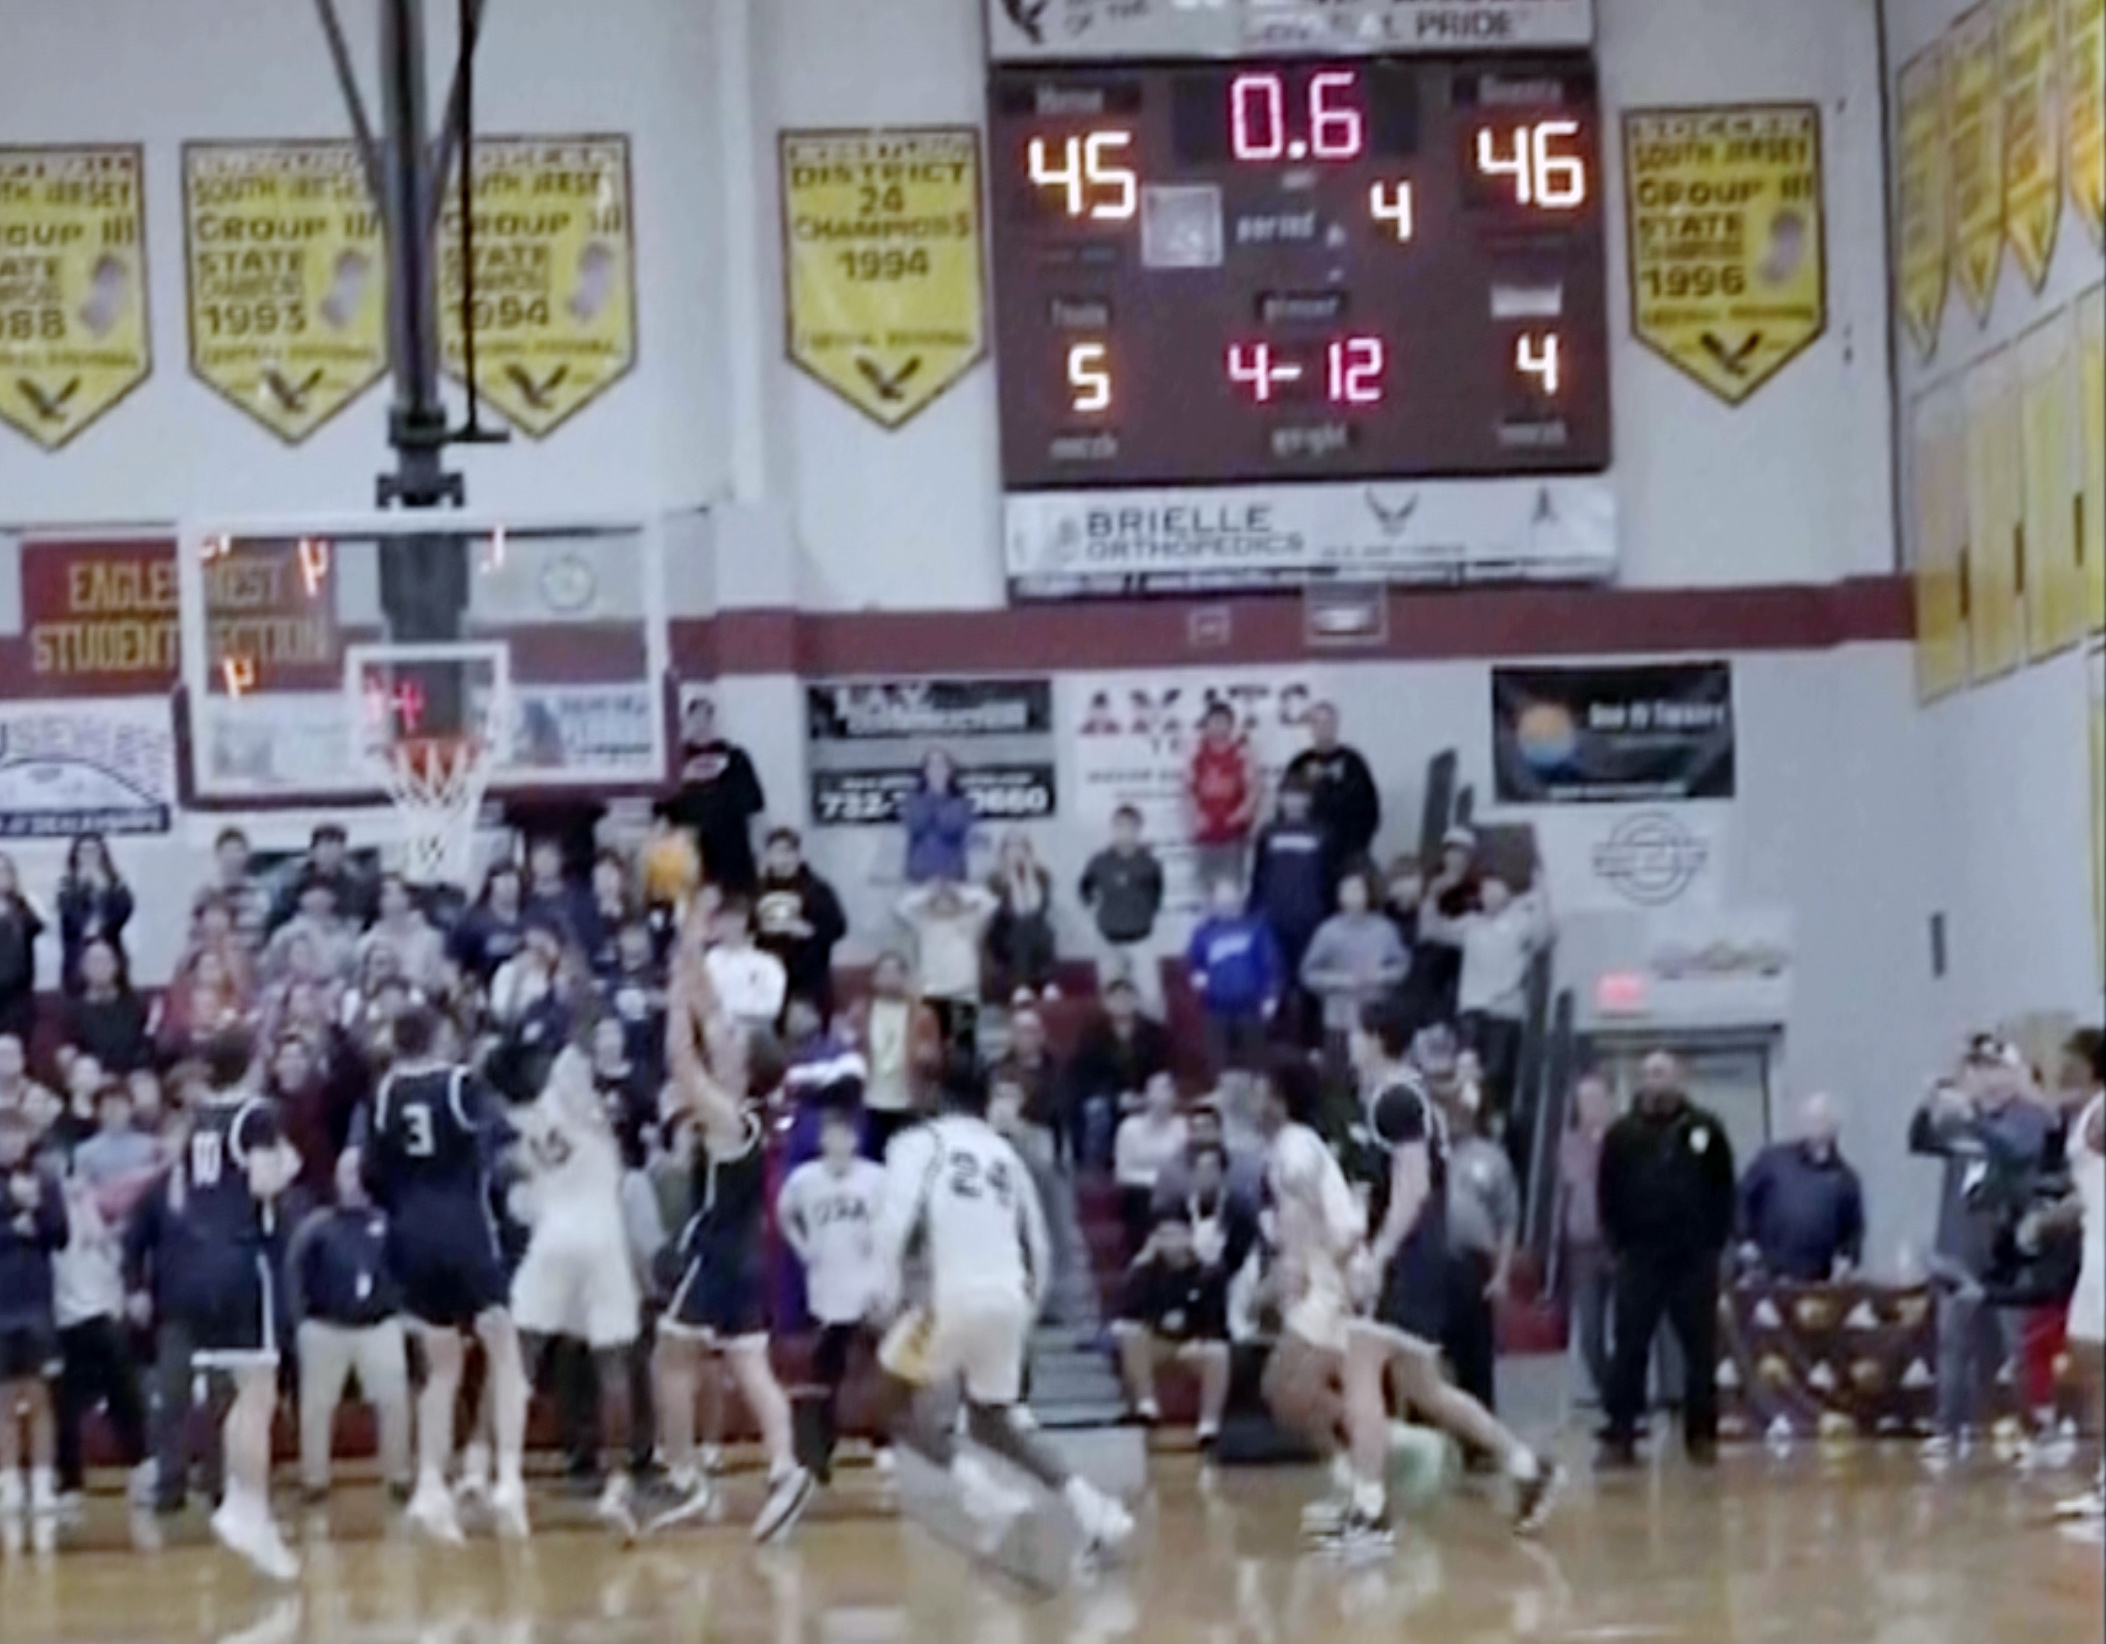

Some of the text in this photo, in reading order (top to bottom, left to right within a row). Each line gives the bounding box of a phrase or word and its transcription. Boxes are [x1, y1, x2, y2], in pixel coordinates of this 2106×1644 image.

[1416, 9, 1513, 38] PRIDE
[1231, 72, 1362, 159] 0.6
[792, 161, 966, 188] DISTRICT
[1028, 131, 1137, 219] 45
[1477, 121, 1586, 208] 46
[1637, 177, 1764, 207] GROUP
[1369, 180, 1413, 242] 4
[1, 222, 84, 246] OUP
[197, 214, 328, 242] GROUP
[198, 248, 304, 273] STATE
[838, 248, 929, 281] 1994
[1641, 264, 1746, 297] 1996
[1067, 342, 1111, 412] 5
[1517, 333, 1561, 396] 4
[1086, 505, 1273, 539] BRIELLE
[1085, 534, 1304, 561] ORTHOPEDICS
[68, 560, 180, 612] EAGLE
[401, 1103, 435, 1157] 3
